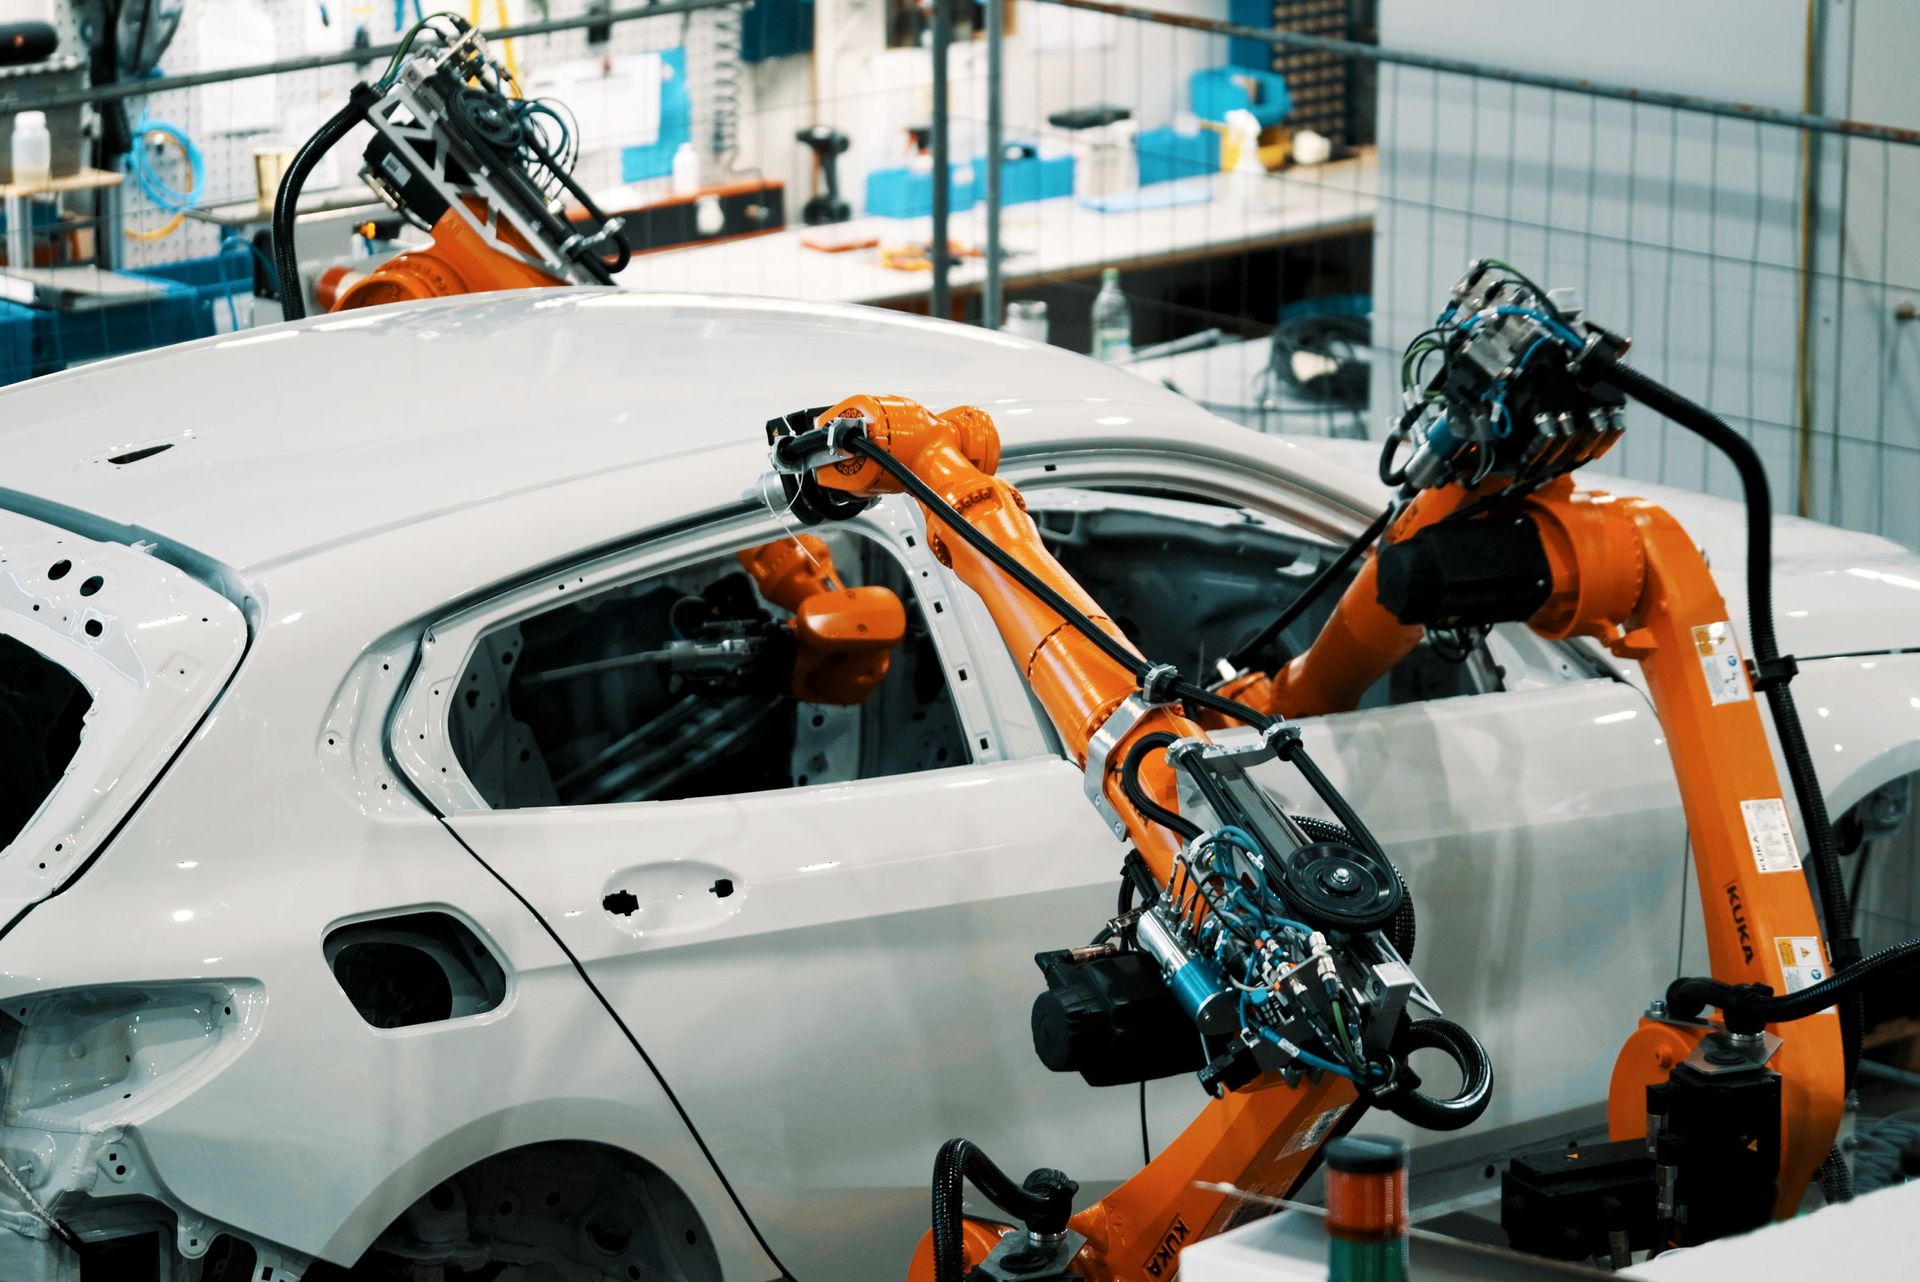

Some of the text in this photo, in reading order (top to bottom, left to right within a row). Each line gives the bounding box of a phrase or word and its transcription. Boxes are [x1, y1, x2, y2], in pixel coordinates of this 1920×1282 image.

[1752, 836, 1767, 870] KUKA
[1727, 886, 1754, 965] KUKA
[1147, 1219, 1190, 1277] KUKA
